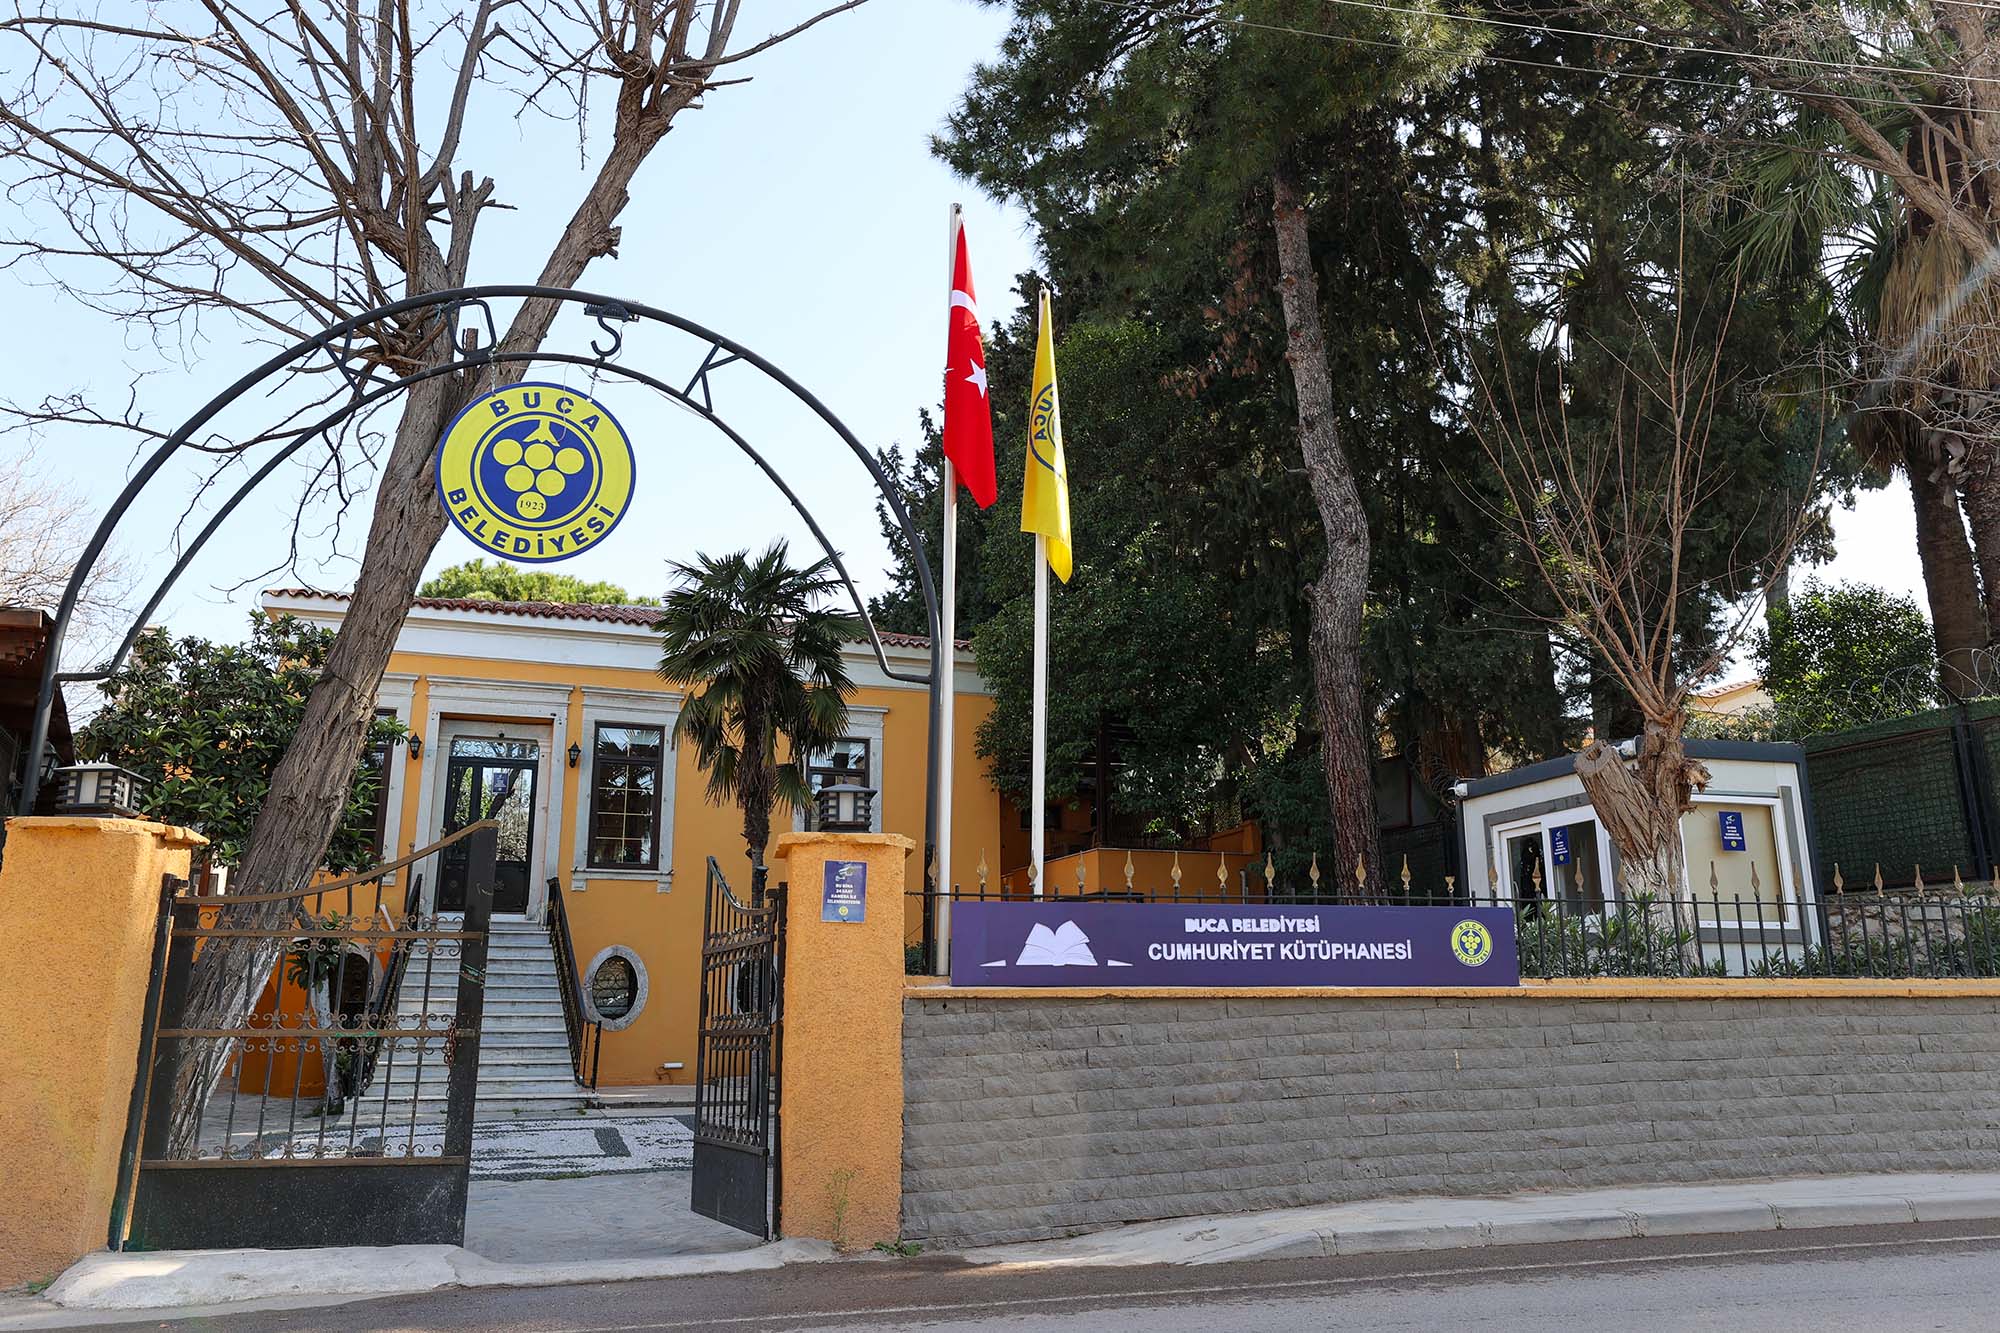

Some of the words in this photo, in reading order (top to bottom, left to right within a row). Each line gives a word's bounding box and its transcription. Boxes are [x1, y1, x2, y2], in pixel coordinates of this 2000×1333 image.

[489, 392, 600, 432] BUCA
[520, 500, 544, 511] 1923
[448, 487, 615, 555] BELEDİYESİ
[1185, 918, 1230, 933] BUCA
[1231, 915, 1320, 933] BELEDİYESİ
[1148, 939, 1275, 961] CUMHURİYET
[1280, 939, 1412, 960] KÜTÜPHANESİ
